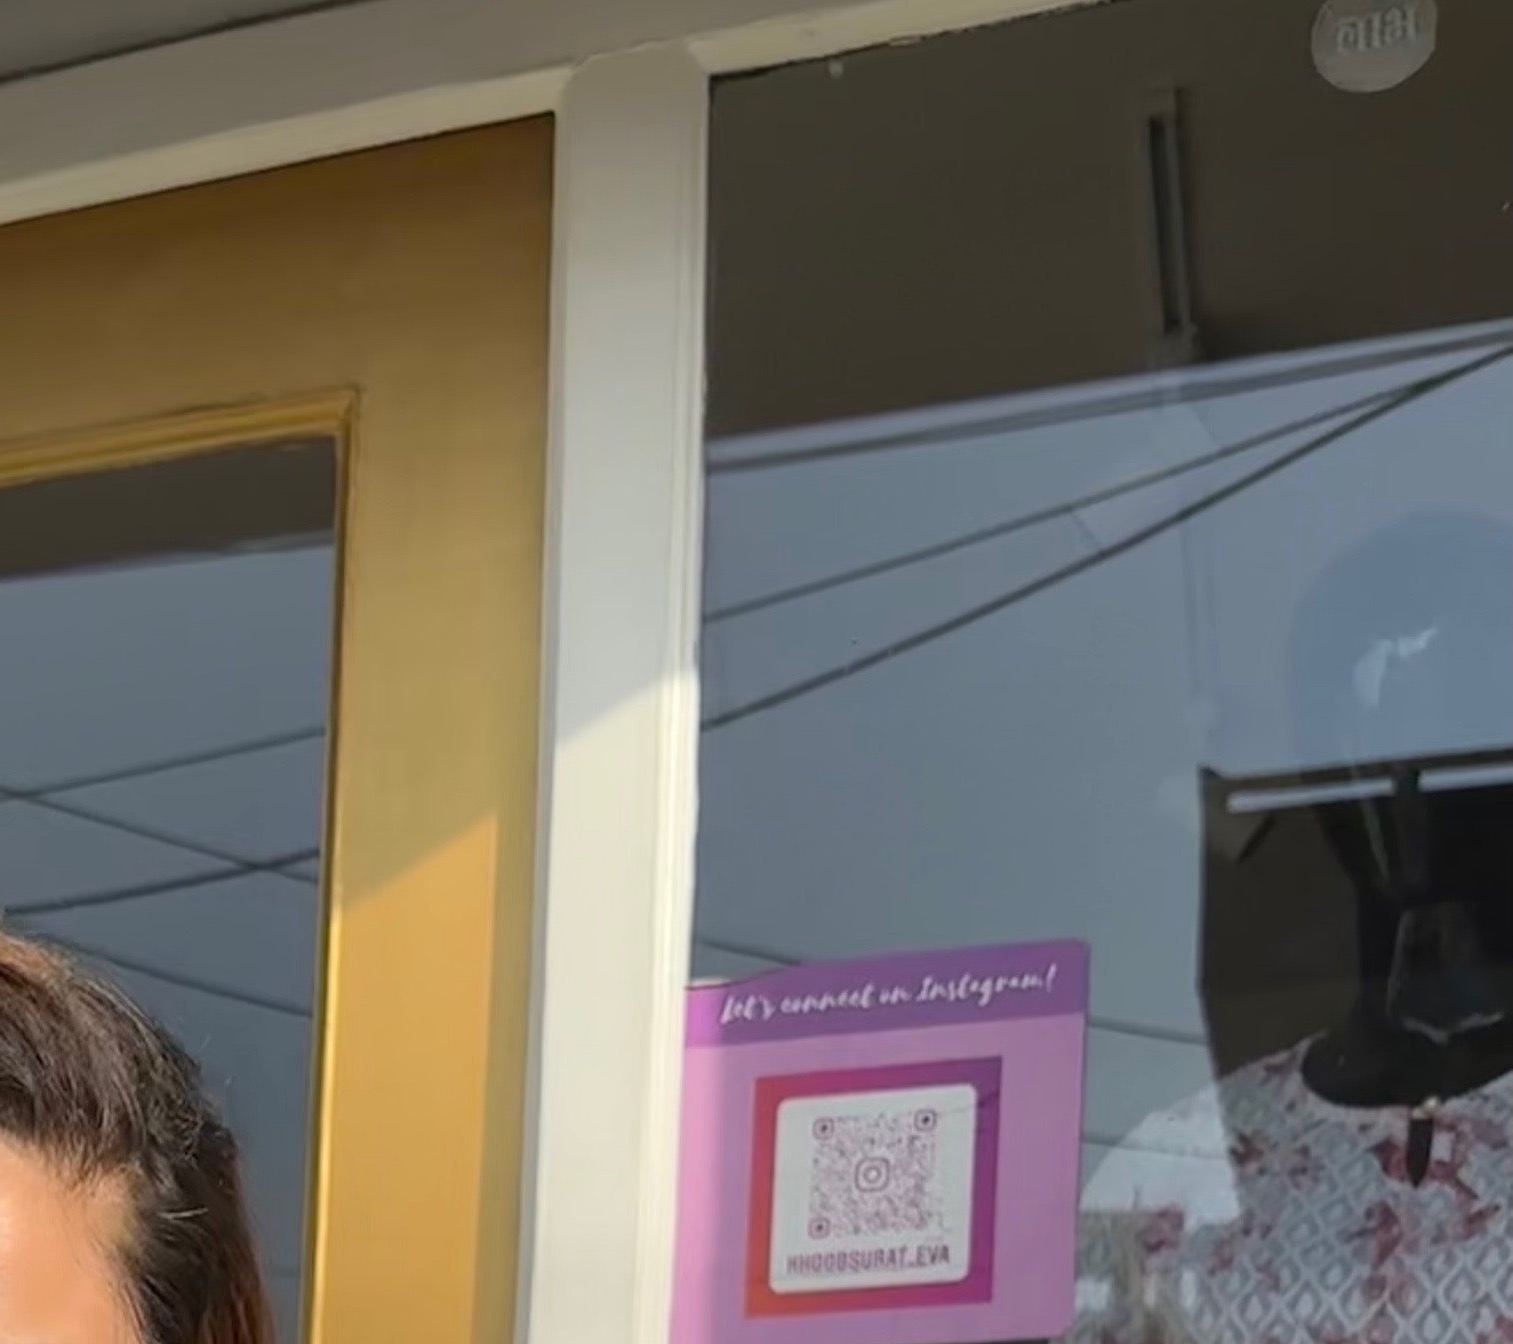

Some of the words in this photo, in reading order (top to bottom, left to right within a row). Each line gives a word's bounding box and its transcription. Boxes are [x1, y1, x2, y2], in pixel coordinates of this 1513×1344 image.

[720, 995, 775, 1024] Let's
[781, 984, 875, 1014] connect
[879, 988, 908, 1005] on
[916, 963, 1057, 1007] Instagram!
